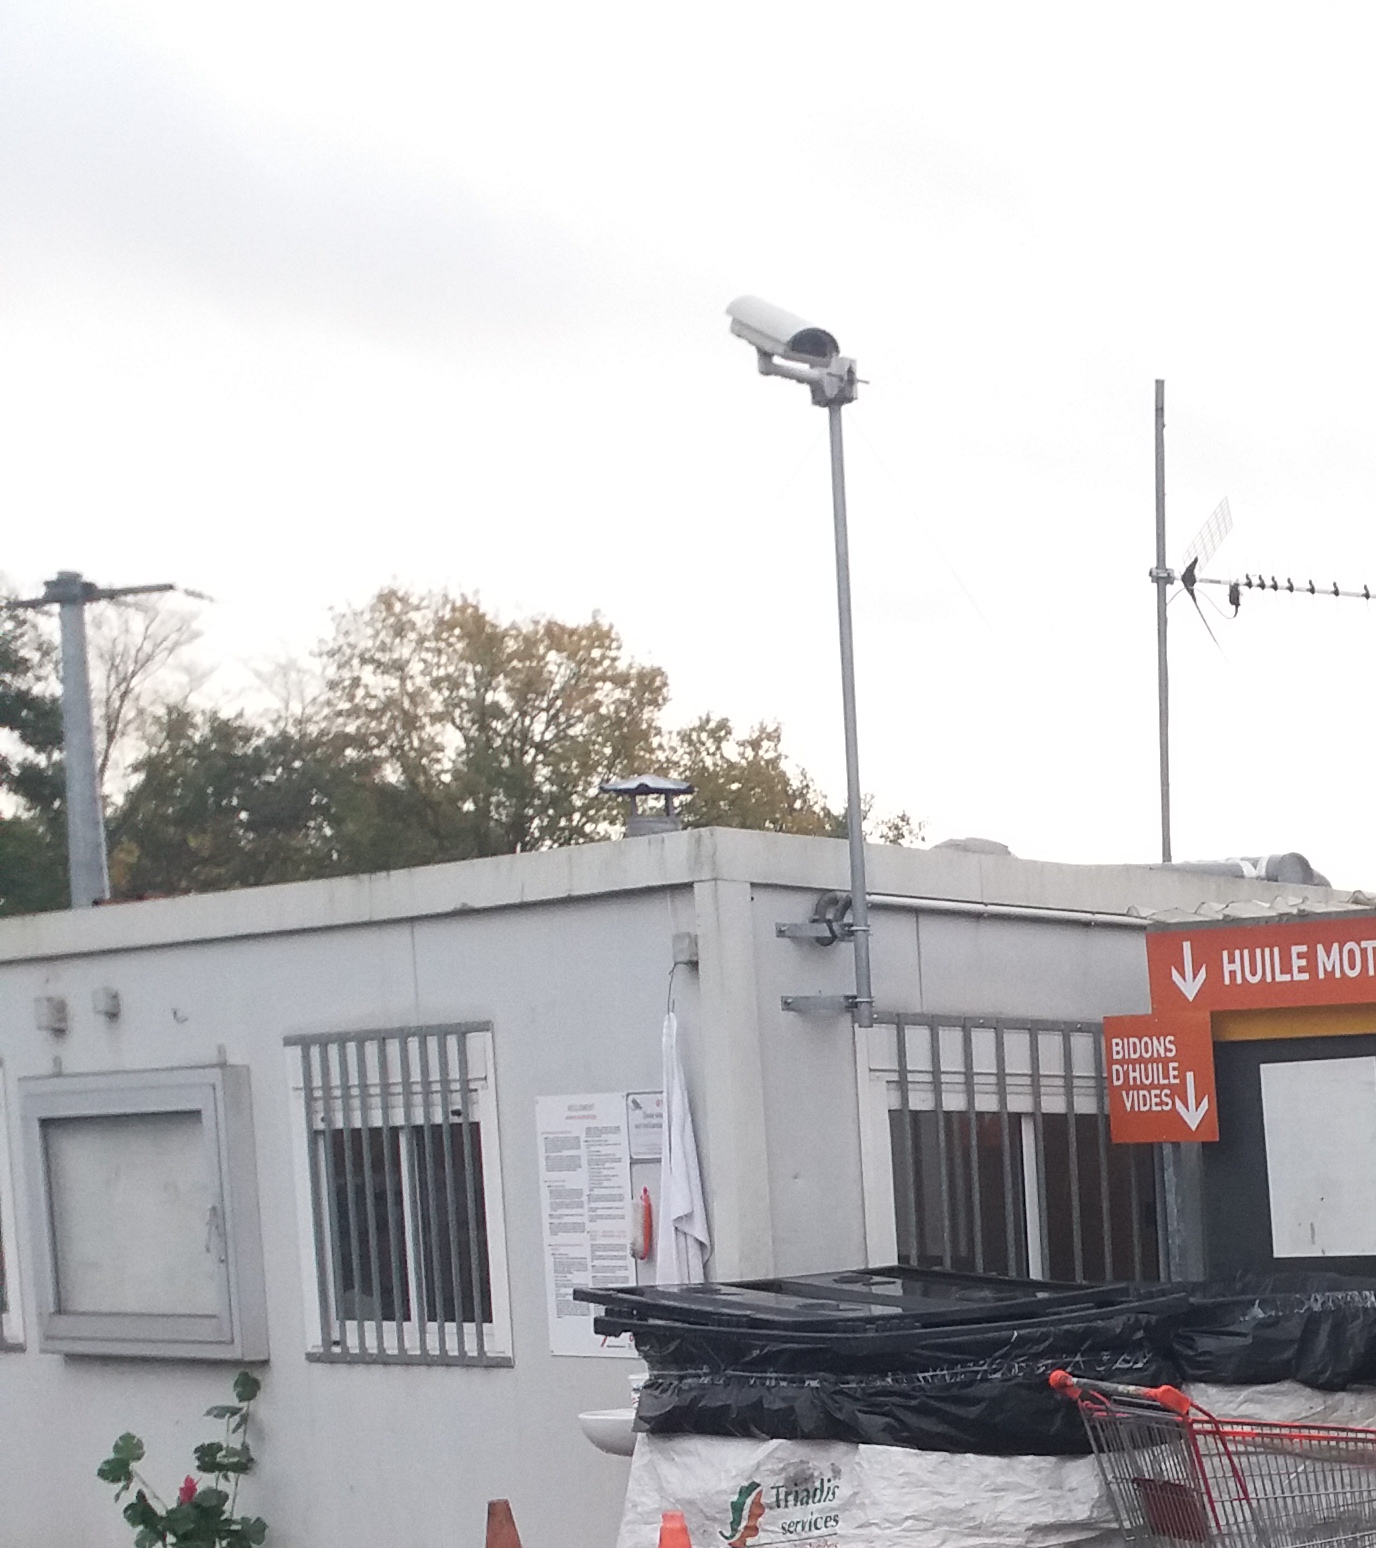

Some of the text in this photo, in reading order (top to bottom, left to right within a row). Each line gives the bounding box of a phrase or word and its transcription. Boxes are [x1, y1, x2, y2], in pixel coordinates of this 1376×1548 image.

[1222, 945, 1309, 985] HUILE
[1112, 1036, 1176, 1060] BIDONS
[1112, 1062, 1180, 1086] D'HUILE
[1122, 1090, 1173, 1112] VIDES
[770, 1477, 839, 1508] Triadis
[781, 1512, 839, 1535] services
